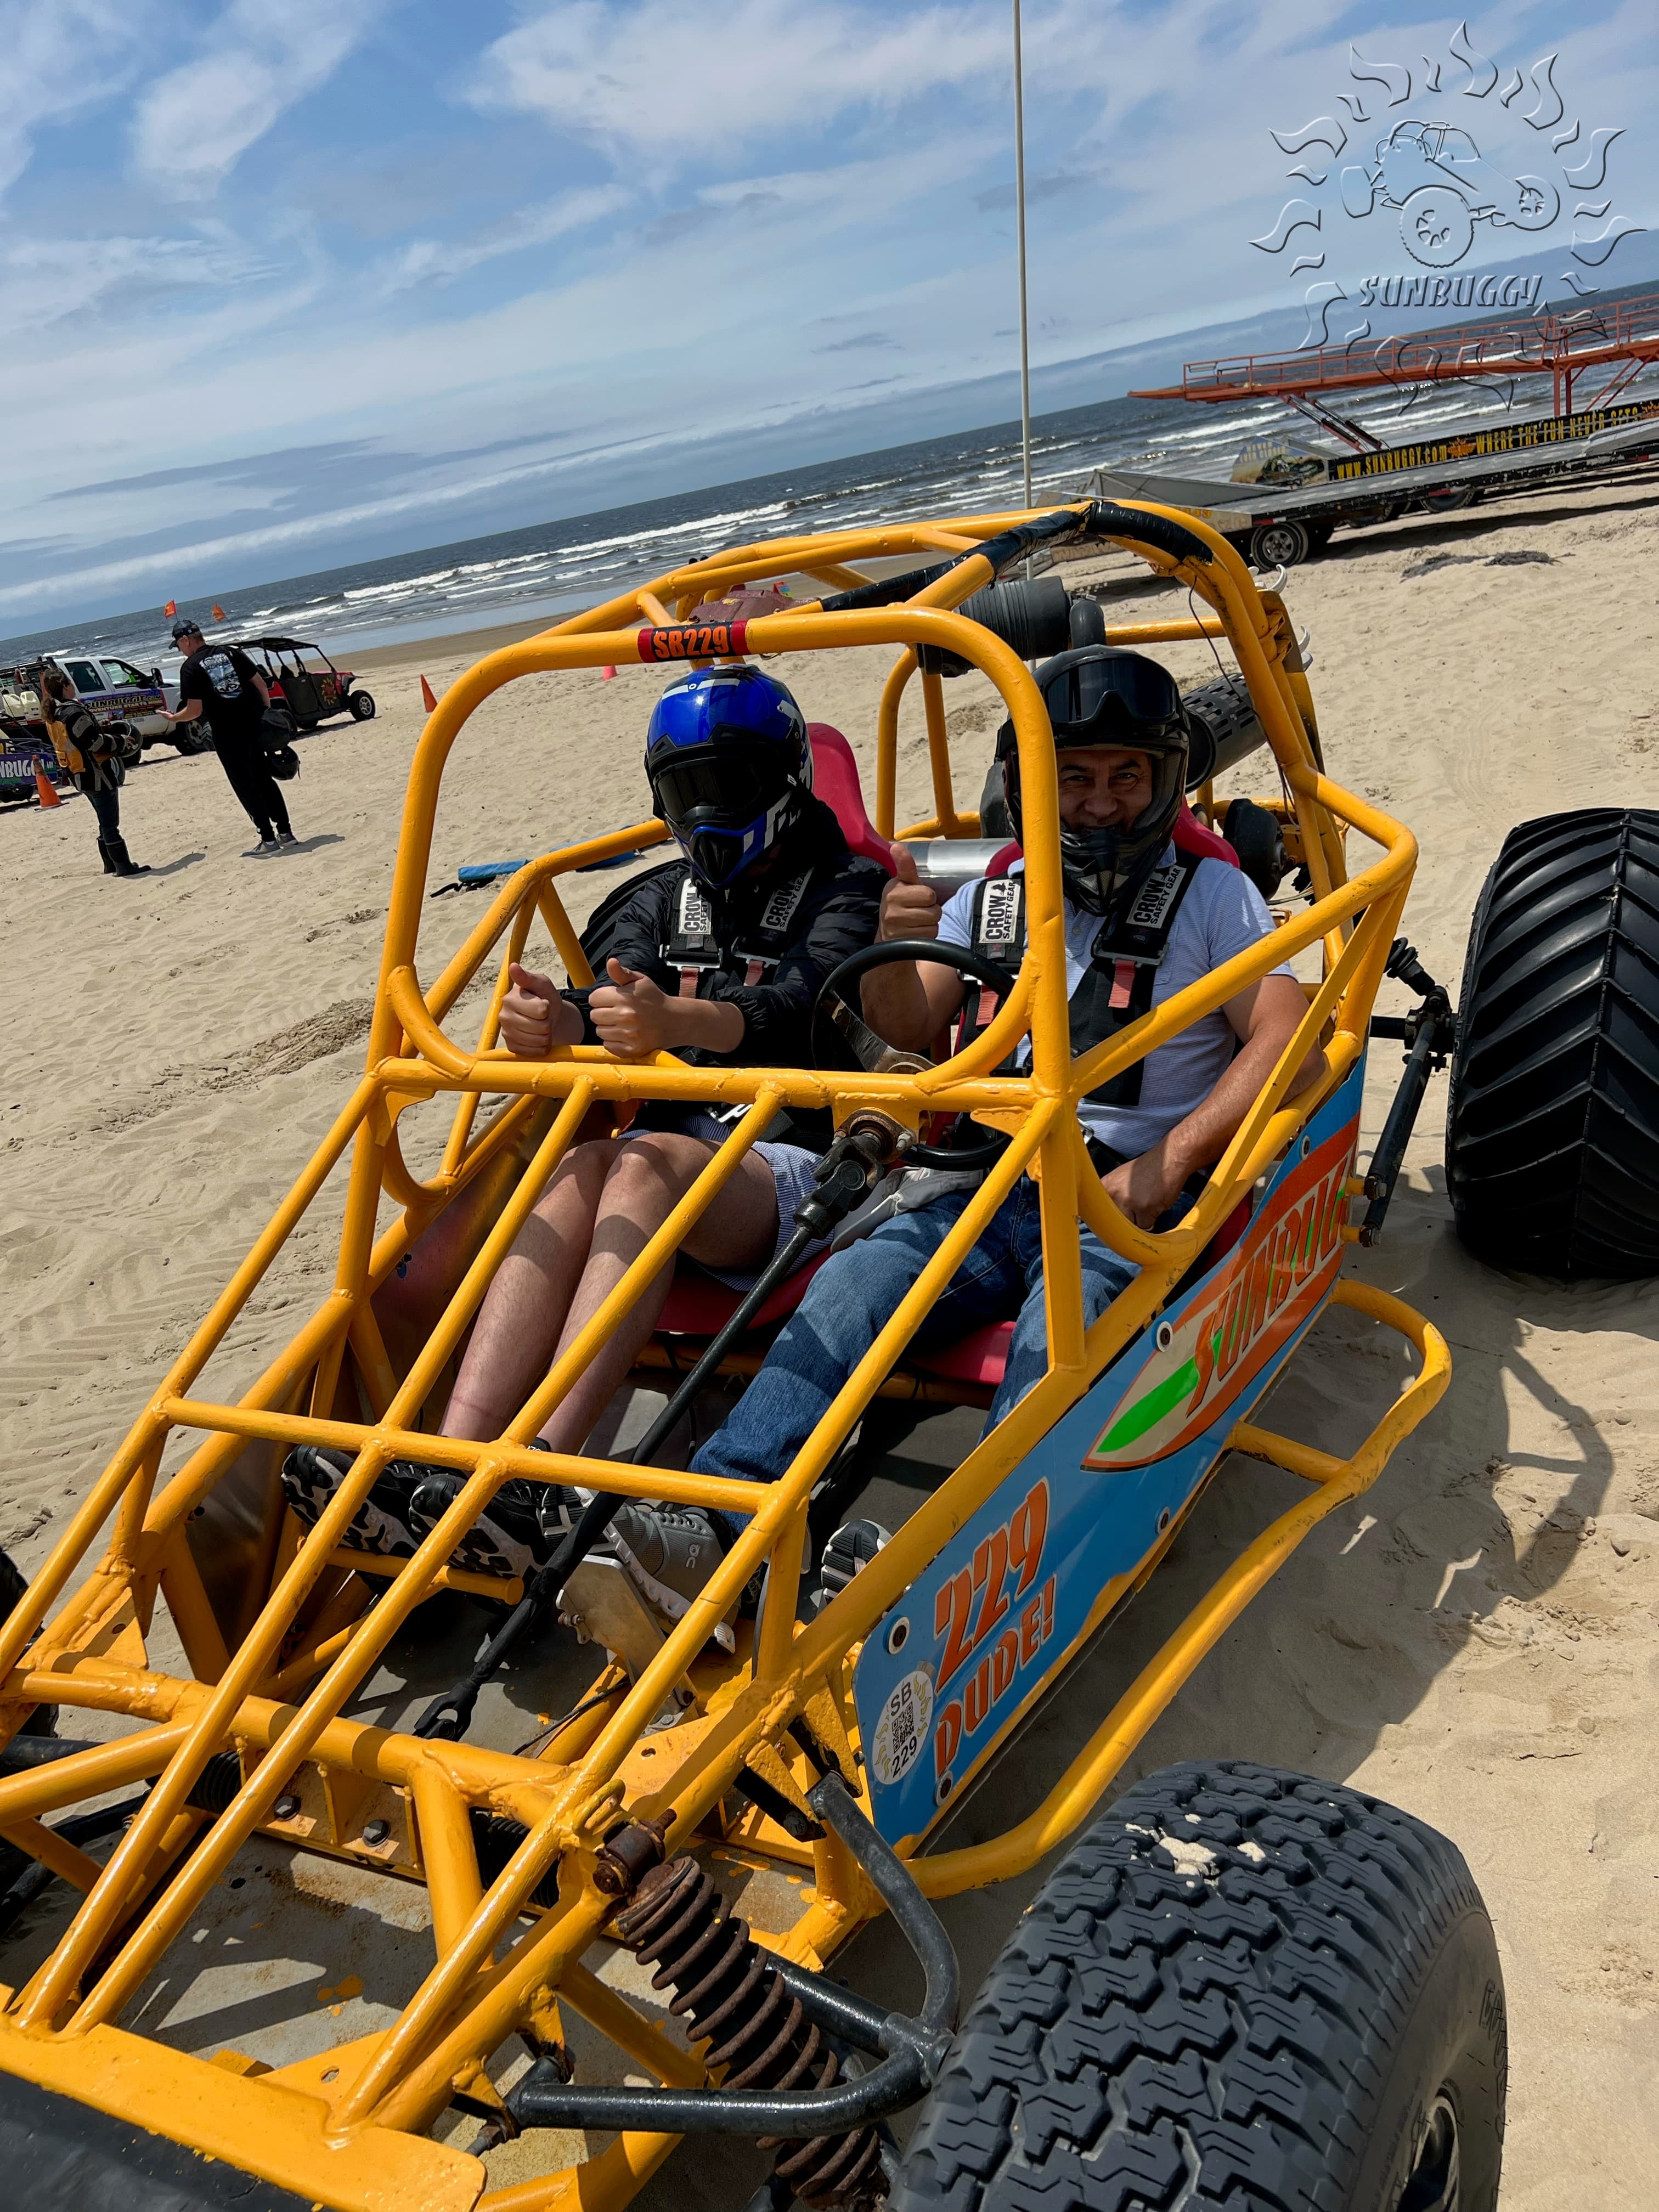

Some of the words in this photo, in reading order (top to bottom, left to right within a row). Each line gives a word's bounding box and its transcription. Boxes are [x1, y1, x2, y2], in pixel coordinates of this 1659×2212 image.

[1475, 429, 1514, 454] WHERE
[1517, 425, 1538, 447] THE
[1543, 420, 1564, 442] FUN
[1570, 413, 1605, 438] NEVER
[653, 625, 729, 659] SB229
[89, 704, 123, 713] DVENTURE
[765, 882, 795, 927] CROW
[780, 893, 798, 928] SAFETY
[794, 873, 806, 892] GEA
[1006, 882, 1015, 901] GEAR
[1133, 878, 1166, 923] CROW
[1150, 890, 1170, 924] SAFETY
[1165, 868, 1181, 889] GEAR
[985, 895, 1006, 940] CROW
[1002, 904, 1013, 940] SAFETY
[935, 1480, 1048, 1694] 229
[890, 1681, 912, 1717] SB
[935, 1576, 1056, 1778] DUDE!
[892, 1735, 918, 1779] 229
